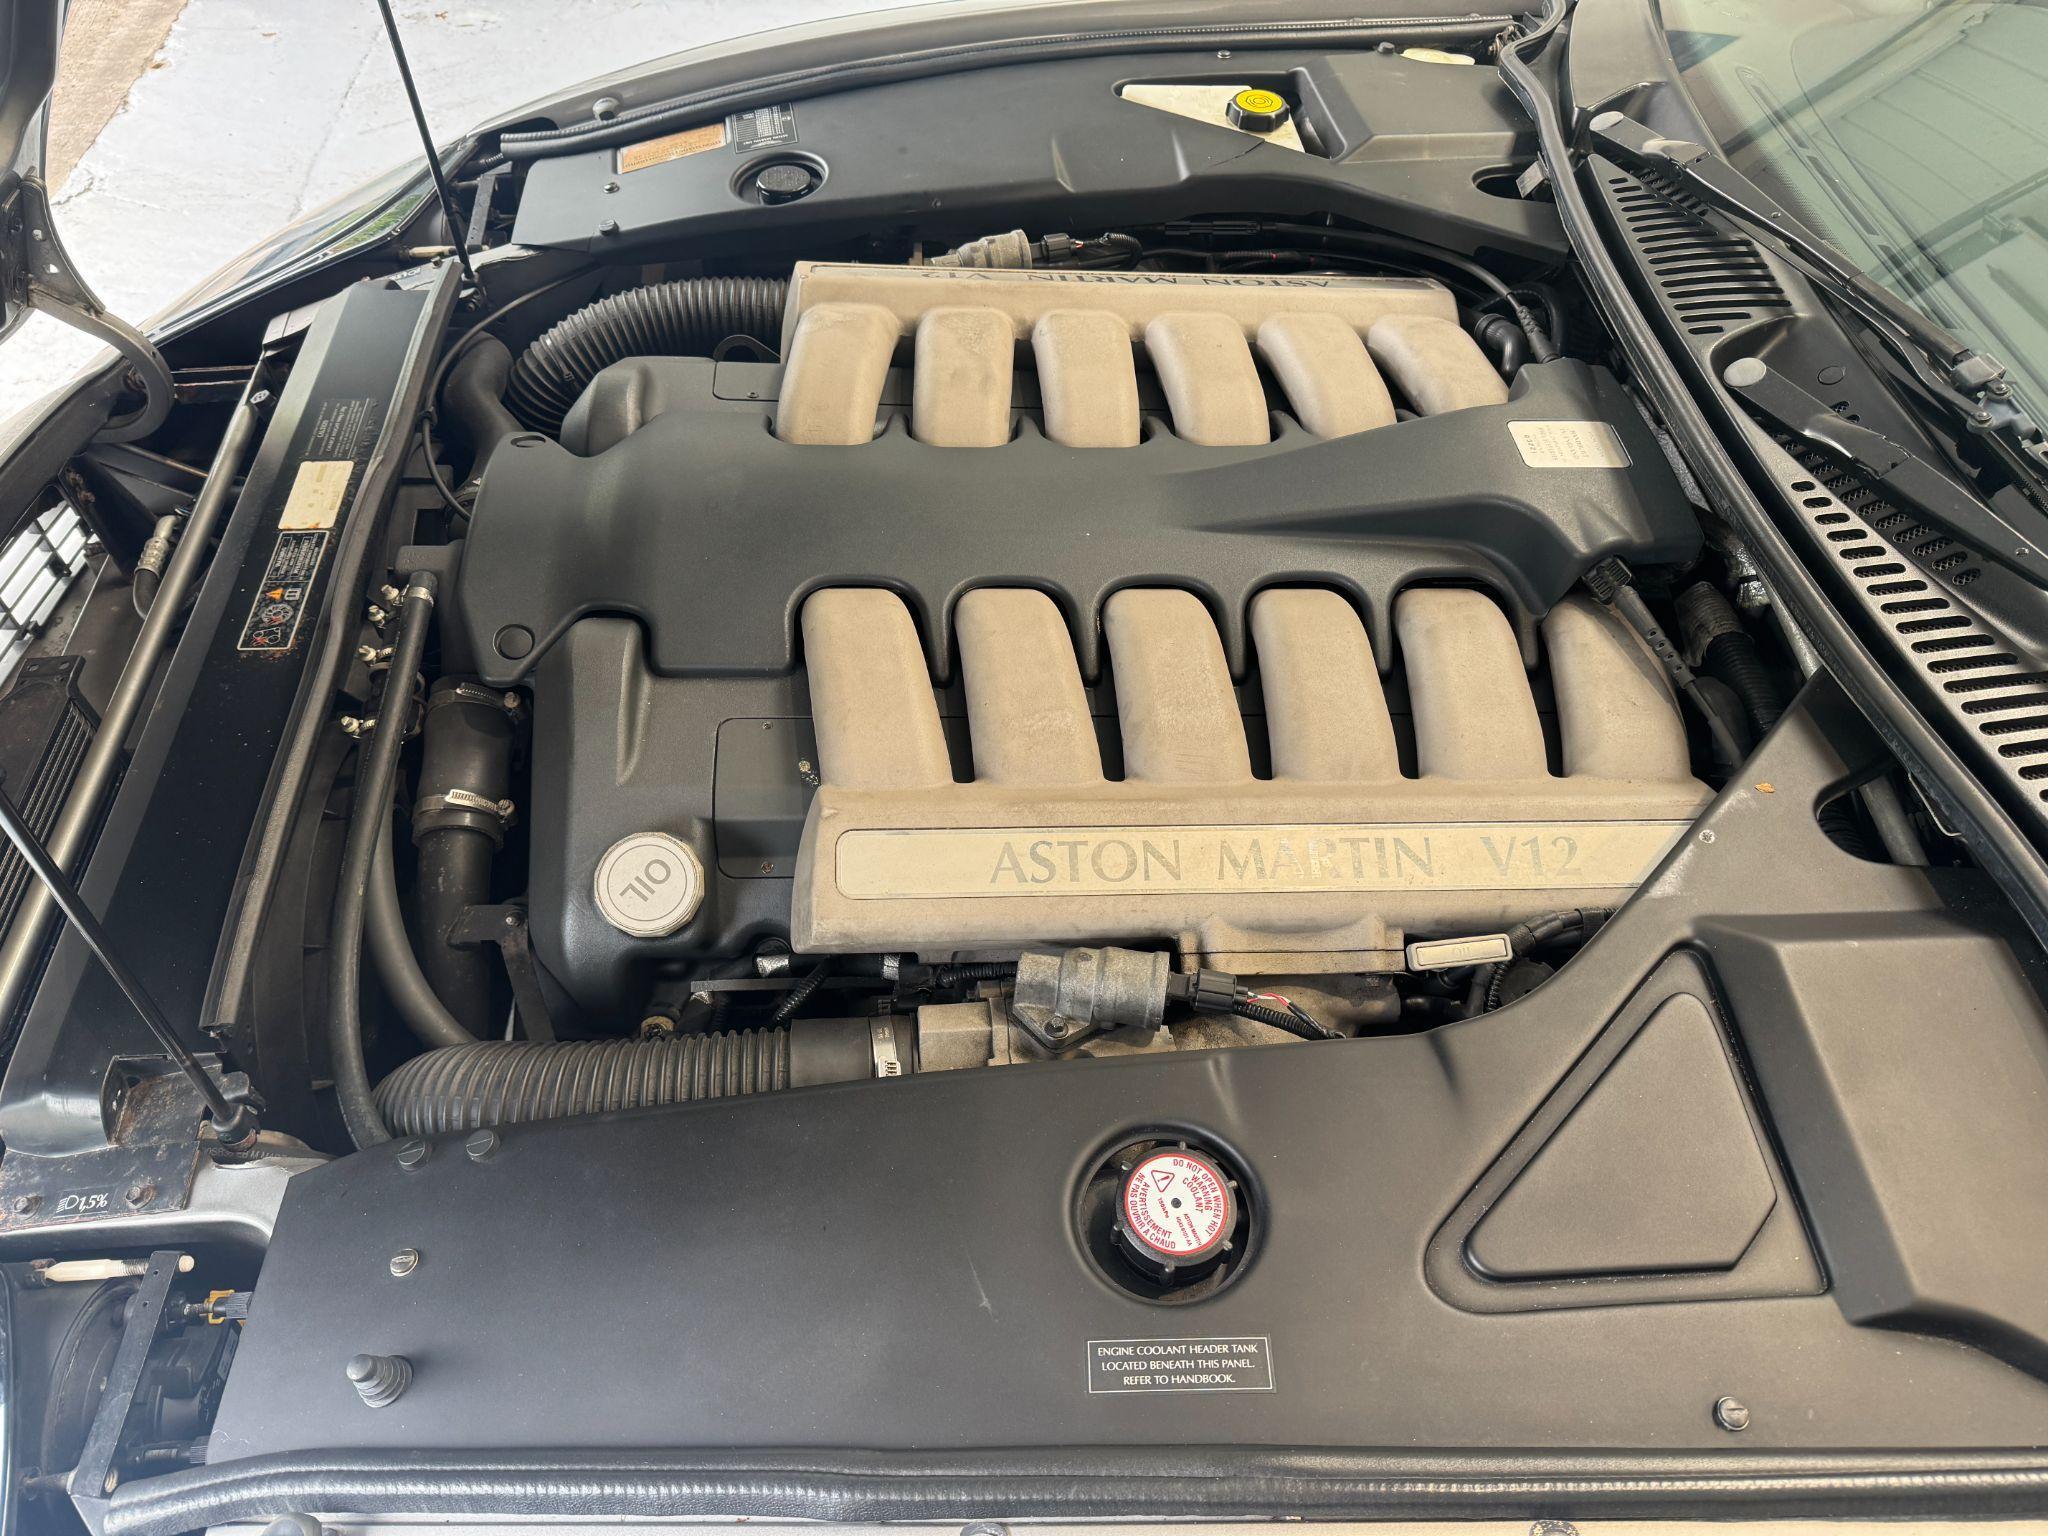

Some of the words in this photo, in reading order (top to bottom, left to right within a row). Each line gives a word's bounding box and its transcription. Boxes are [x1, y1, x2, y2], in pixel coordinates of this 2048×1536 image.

[1027, 274, 1178, 286] MARTIN
[1202, 279, 1329, 288] ASTON
[989, 840, 1183, 884] ASTON
[1217, 836, 1435, 881] MARTIN
[1480, 835, 1583, 879] V12
[619, 858, 672, 902] OIL
[1173, 1159, 1184, 1167] DO
[1186, 1161, 1203, 1174] NOT
[1136, 1172, 1145, 1183] NE
[1202, 1173, 1218, 1193] OPEN
[1130, 1184, 1140, 1198] PAS
[1182, 1177, 1204, 1213] COOLANT
[1192, 1174, 1213, 1211] WARNING
[1130, 1200, 1146, 1229] OUVRIR
[1139, 1182, 1172, 1239] AVERTISSEMENT
[1213, 1195, 1222, 1221] WHEN
[1205, 1221, 1219, 1236] HOT
[1149, 1233, 1176, 1249] CHAUD
[1097, 1347, 1134, 1357] ENGINE
[1136, 1345, 1187, 1356] COOLANT
[1189, 1344, 1229, 1355] HEADER
[1231, 1342, 1258, 1354] TANK
[1101, 1361, 1147, 1371] LOCATED
[1150, 1360, 1194, 1370] BENEATH
[1197, 1359, 1220, 1369] THIS
[1221, 1358, 1255, 1369] PANEL.
[1123, 1375, 1152, 1386] REFER
[1153, 1375, 1169, 1385] TO
[1171, 1373, 1236, 1385] HANDBOOK.
